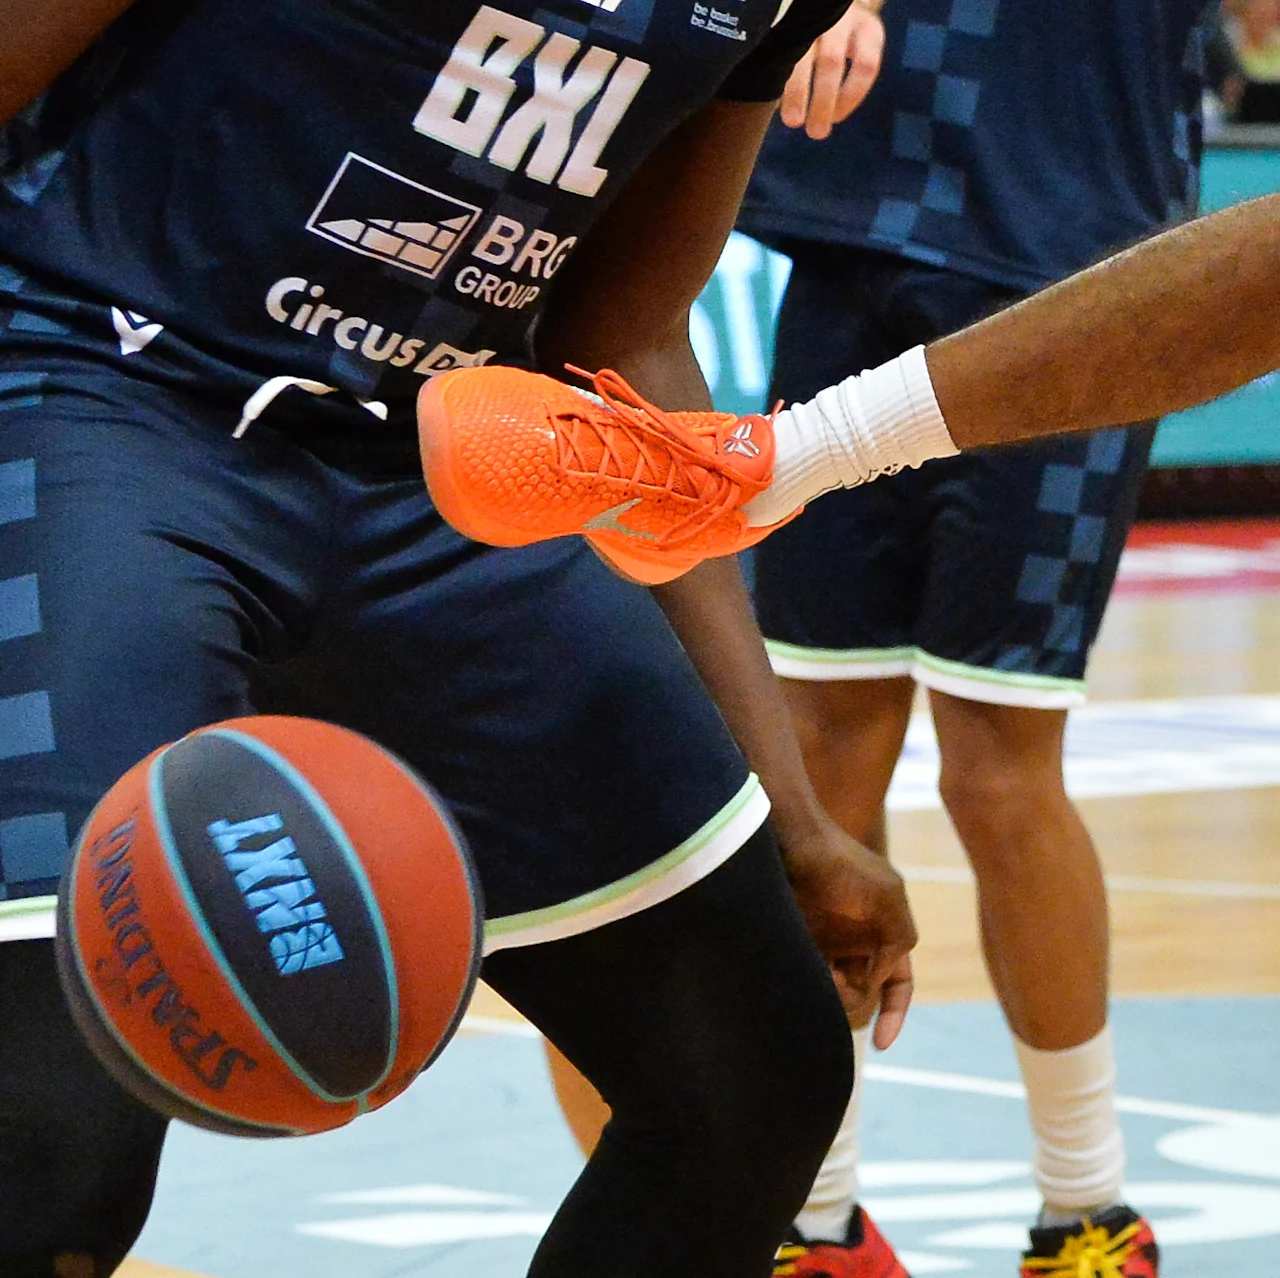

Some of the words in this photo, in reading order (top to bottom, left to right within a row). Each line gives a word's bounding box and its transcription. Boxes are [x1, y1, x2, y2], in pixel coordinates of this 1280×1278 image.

[410, 4, 651, 198] BXL
[454, 266, 540, 310] GROUP
[471, 215, 578, 279] BRG
[265, 276, 427, 369] Circus
[89, 807, 257, 1091] SPALDING
